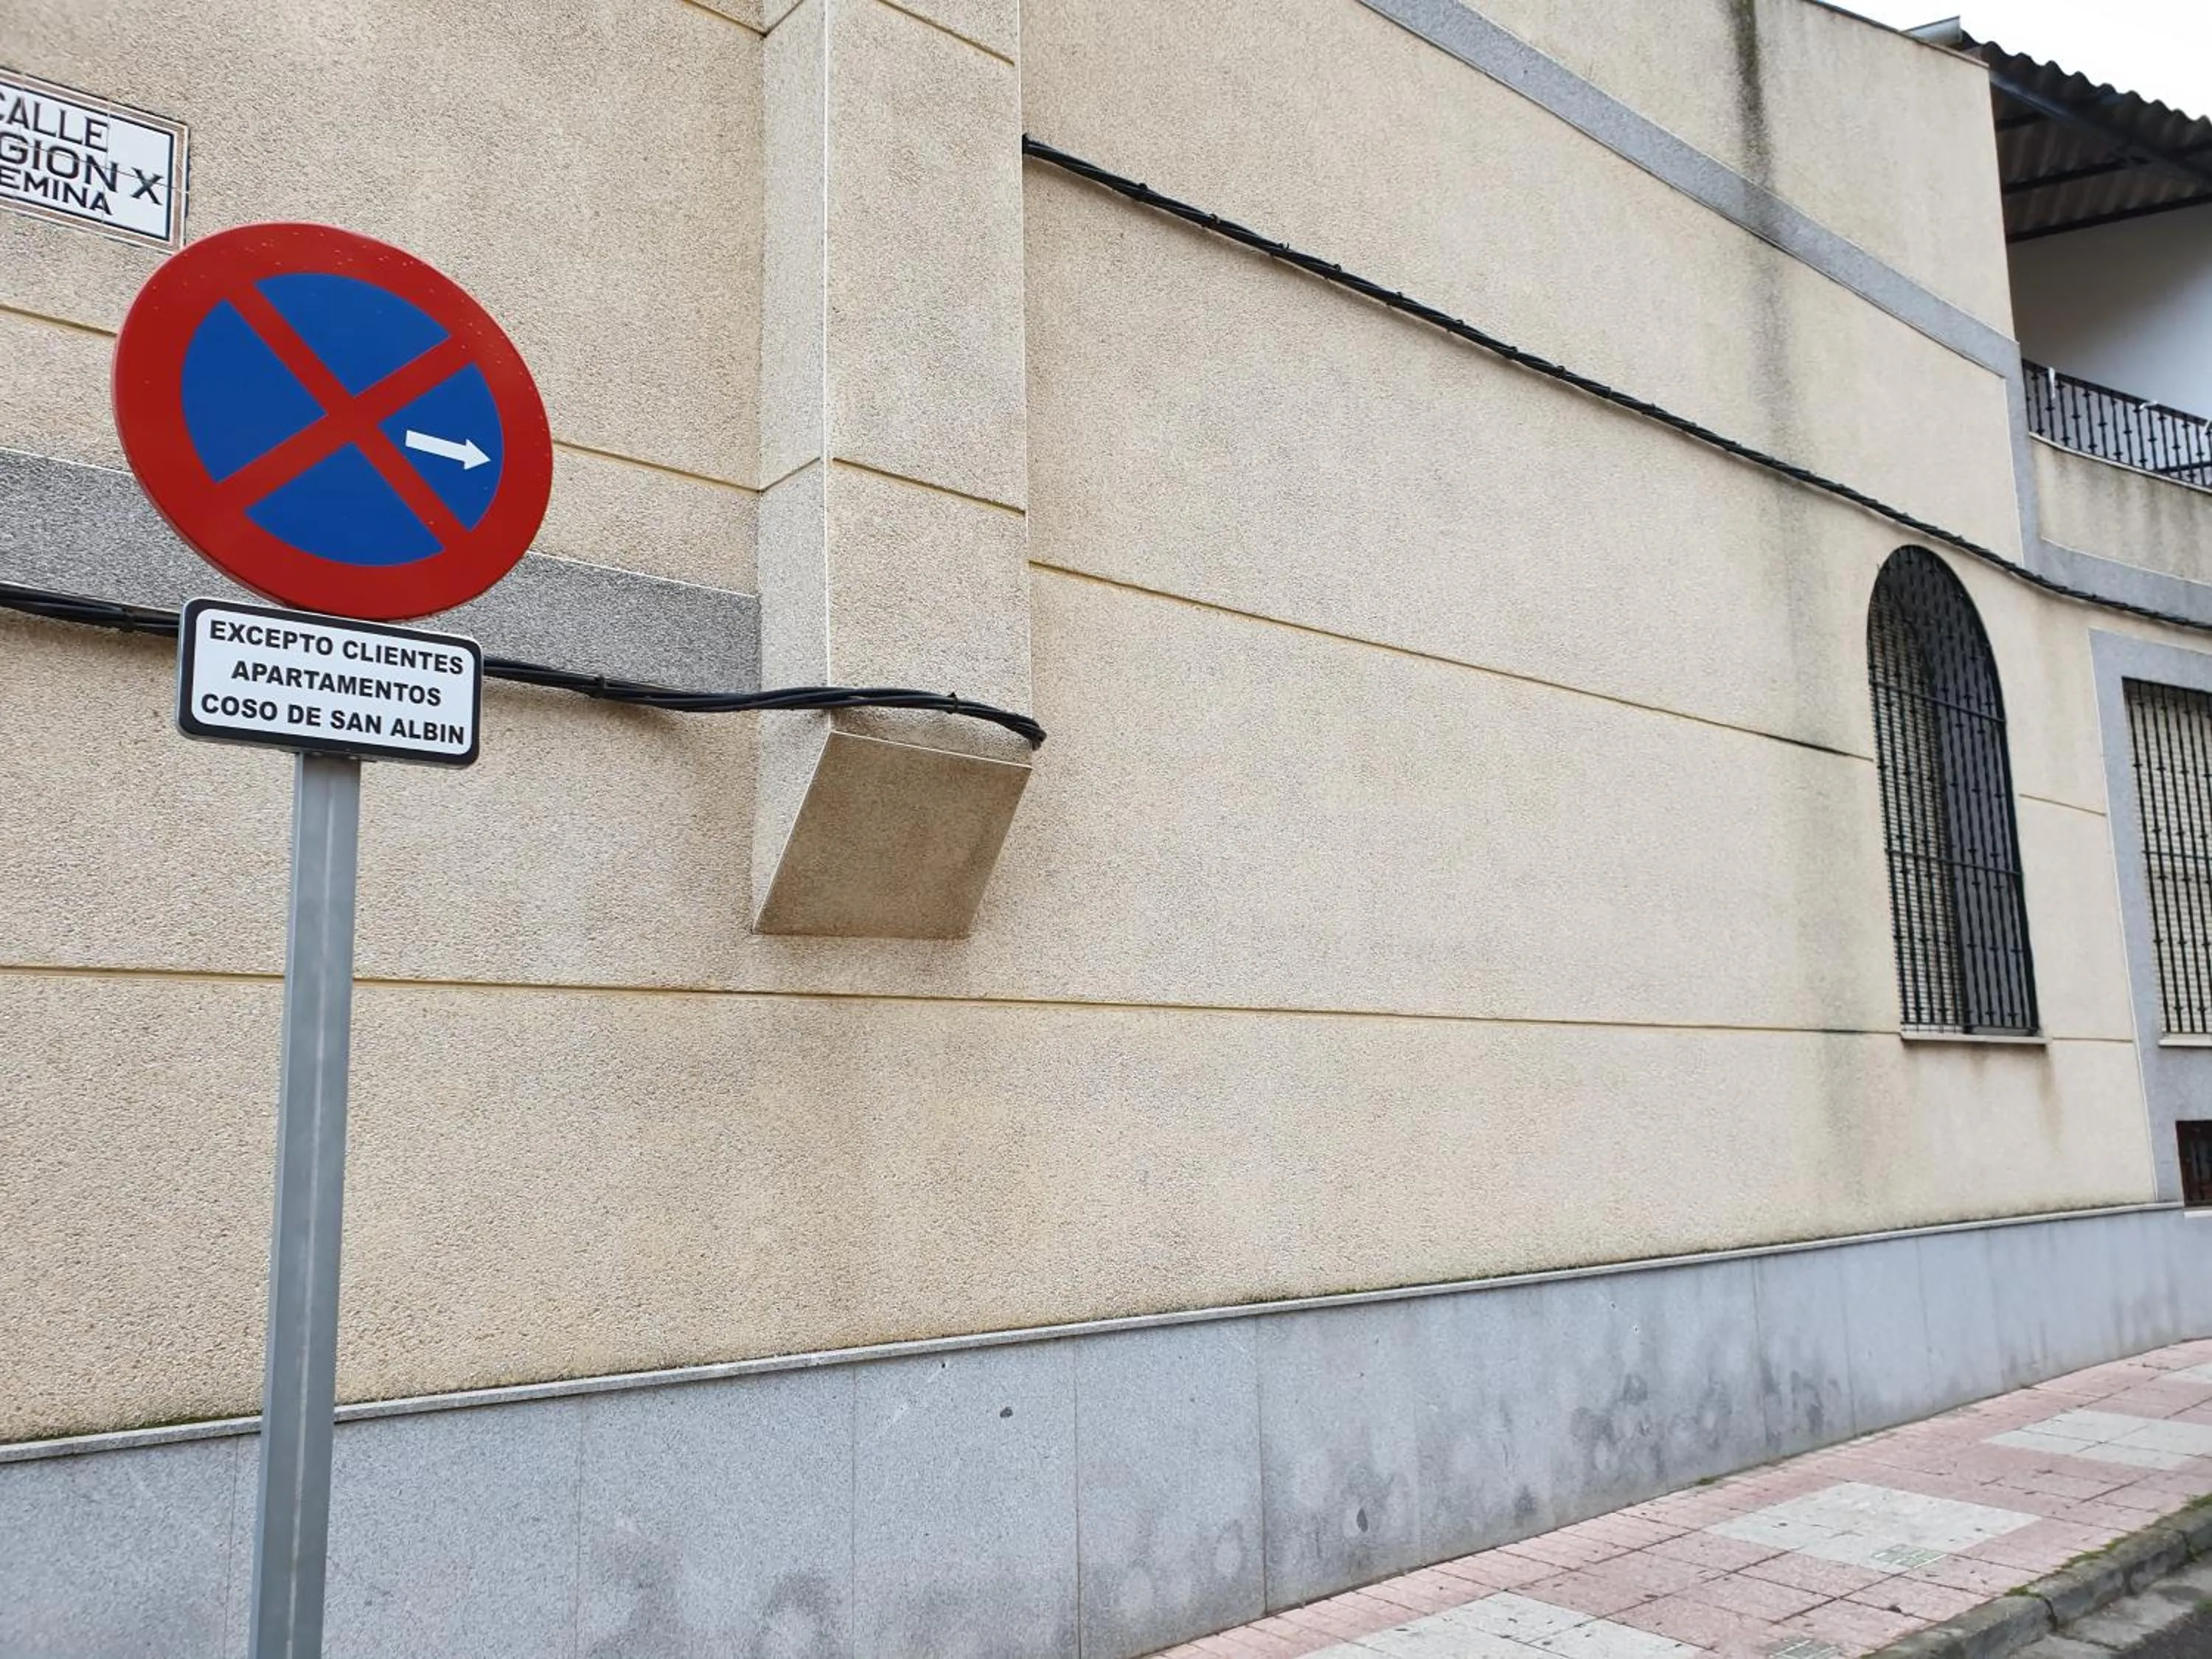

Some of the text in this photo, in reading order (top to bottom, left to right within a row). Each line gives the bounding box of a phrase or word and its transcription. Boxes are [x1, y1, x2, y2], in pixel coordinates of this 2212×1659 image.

[130, 167, 164, 206] X
[209, 619, 464, 675] EXCEPTO CLIENTES
[231, 660, 442, 706] APARTAMENTOS
[201, 693, 465, 745] COSO DE SAN ALBIN
